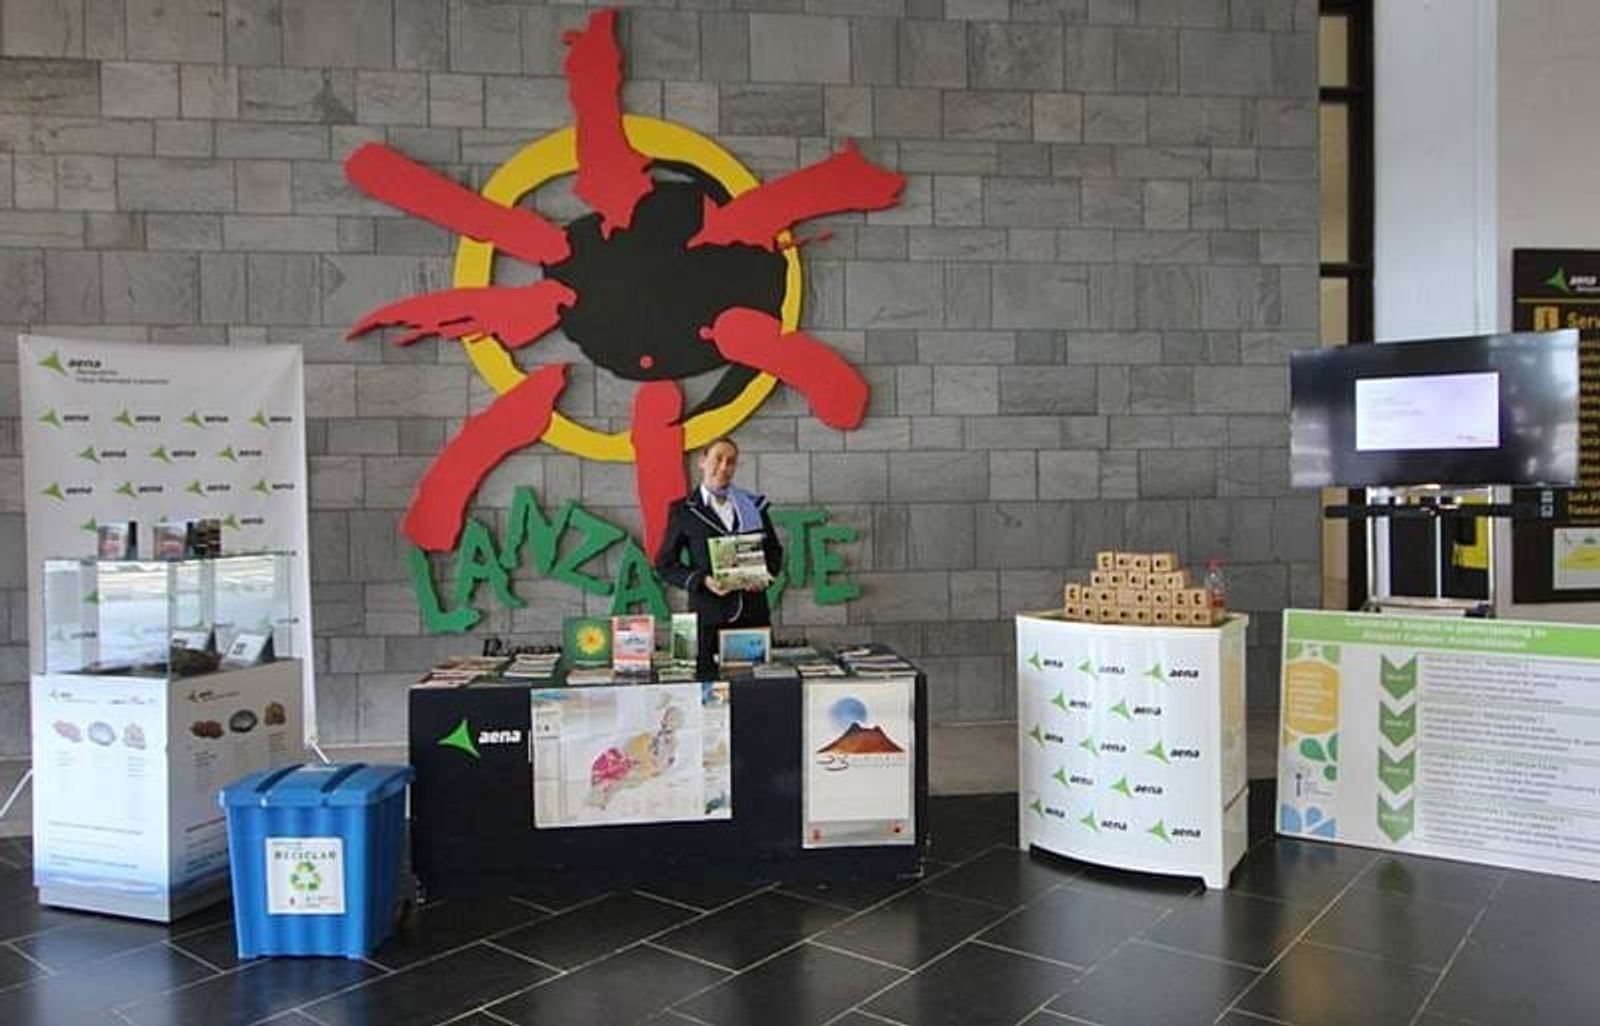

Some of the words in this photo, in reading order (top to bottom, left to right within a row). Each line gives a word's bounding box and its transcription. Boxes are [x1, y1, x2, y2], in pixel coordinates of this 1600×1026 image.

[1168, 668, 1199, 679] aena
[478, 730, 521, 744] aena
[1170, 748, 1200, 759] aena
[1134, 784, 1163, 795] aena
[1171, 827, 1202, 838] aena
